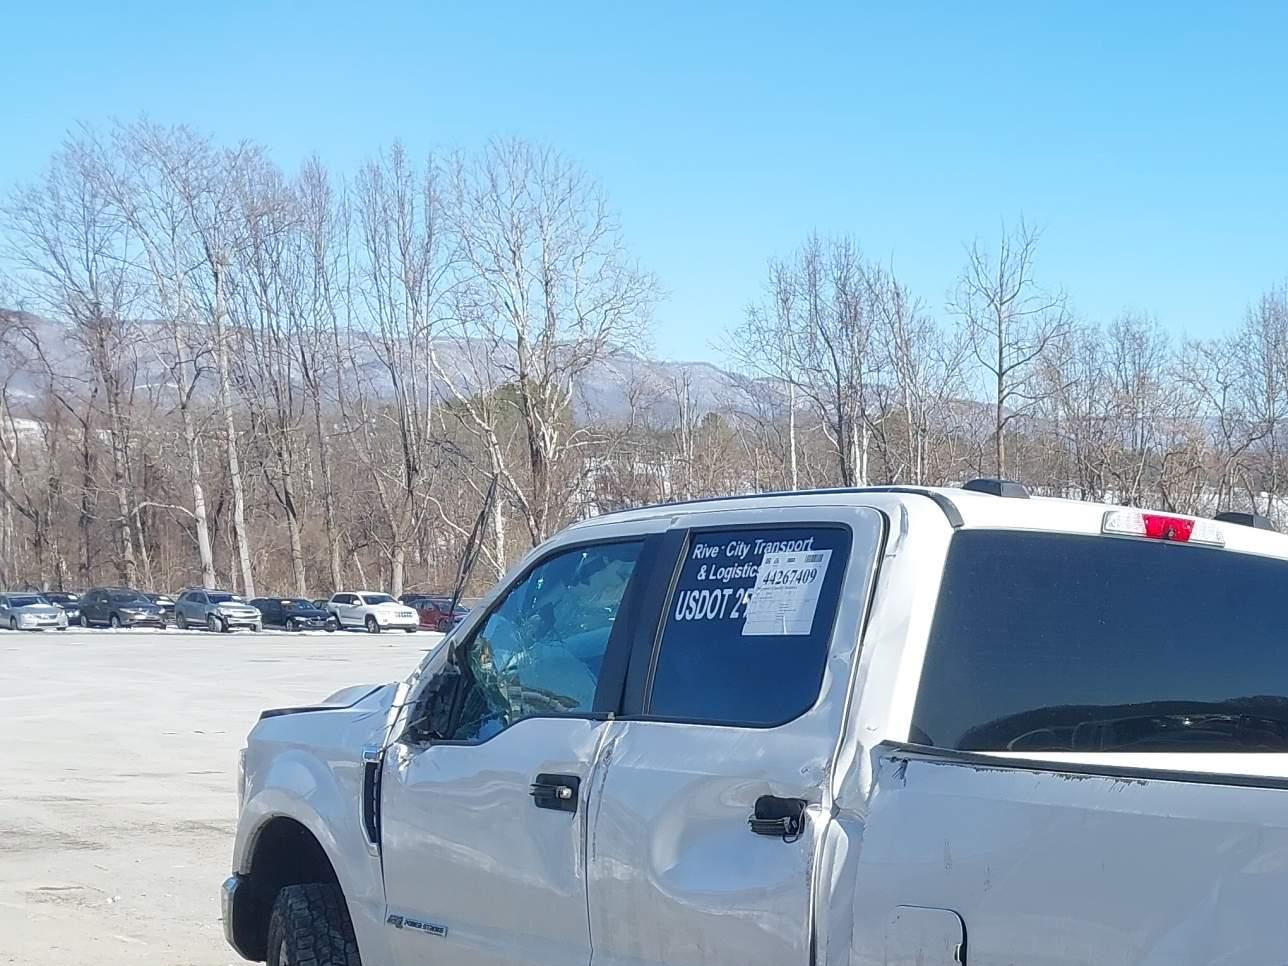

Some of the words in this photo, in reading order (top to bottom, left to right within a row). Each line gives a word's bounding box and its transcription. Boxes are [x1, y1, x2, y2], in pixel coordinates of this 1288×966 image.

[692, 543, 725, 559] Rive
[726, 540, 751, 560] City
[754, 536, 815, 555] Transport
[697, 564, 707, 580] &
[763, 568, 818, 585] 44267409
[675, 588, 734, 620] USDOT
